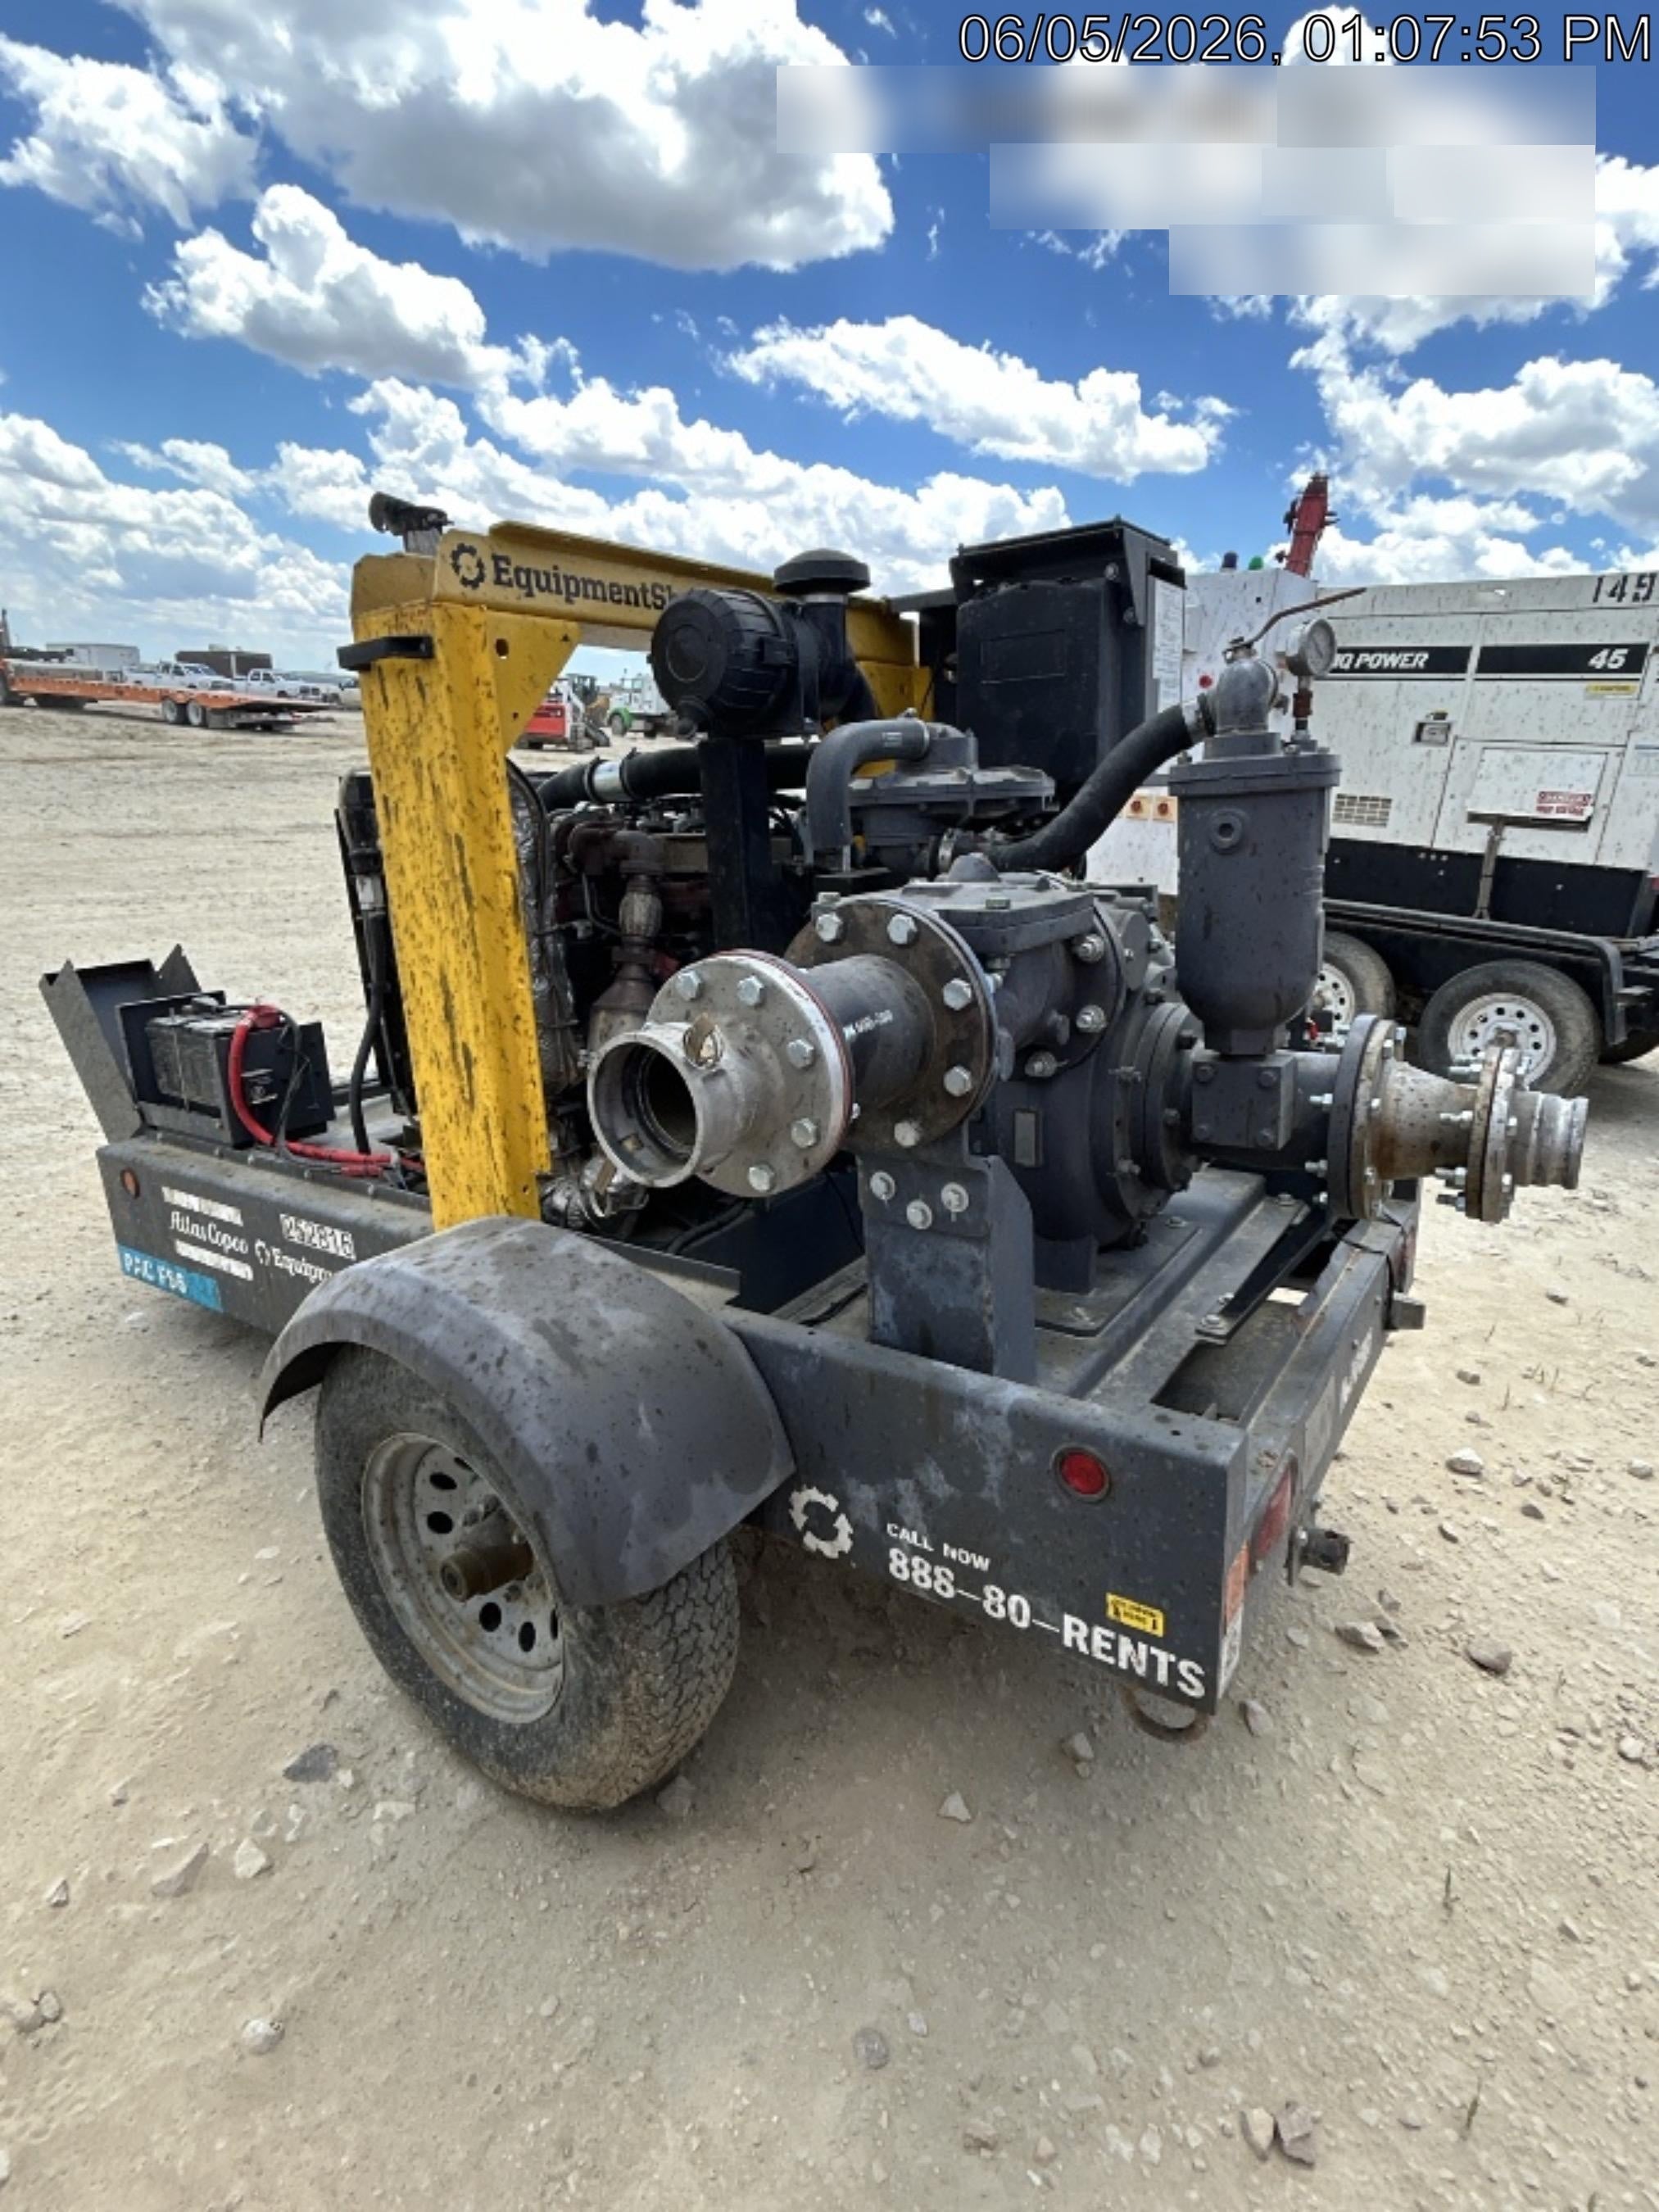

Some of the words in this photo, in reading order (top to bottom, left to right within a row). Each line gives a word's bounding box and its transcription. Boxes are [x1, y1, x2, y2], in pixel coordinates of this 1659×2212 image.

[1354, 652, 1429, 669] POWER
[1588, 648, 1629, 669] 45
[207, 1222, 248, 1253] Copco
[886, 1522, 934, 1552] CALL
[943, 1543, 990, 1571] NOW
